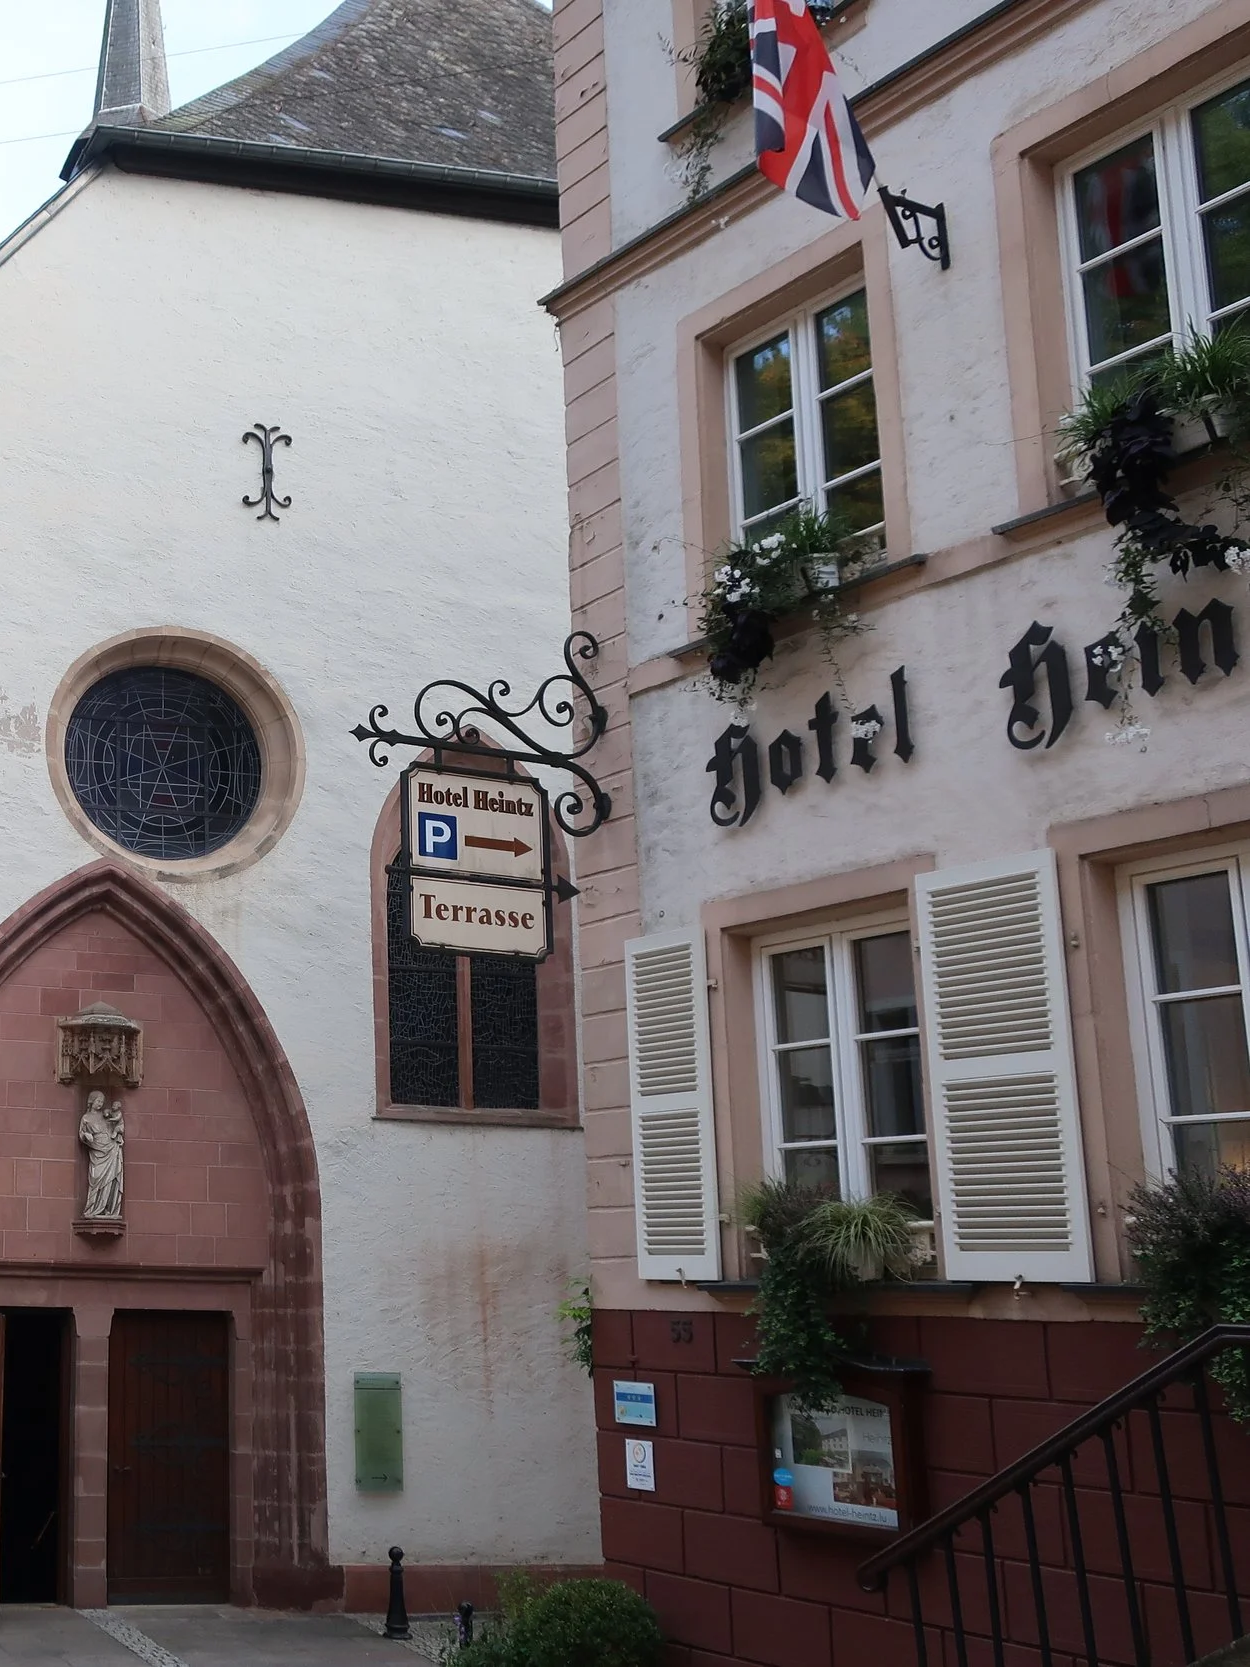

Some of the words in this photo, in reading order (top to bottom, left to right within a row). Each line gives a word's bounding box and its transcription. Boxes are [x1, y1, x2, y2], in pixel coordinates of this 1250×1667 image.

[706, 665, 915, 827] Hotel
[417, 782, 470, 808] Hotel
[473, 789, 534, 817] Heintz
[425, 819, 452, 853] P
[419, 893, 535, 930] Terrasse
